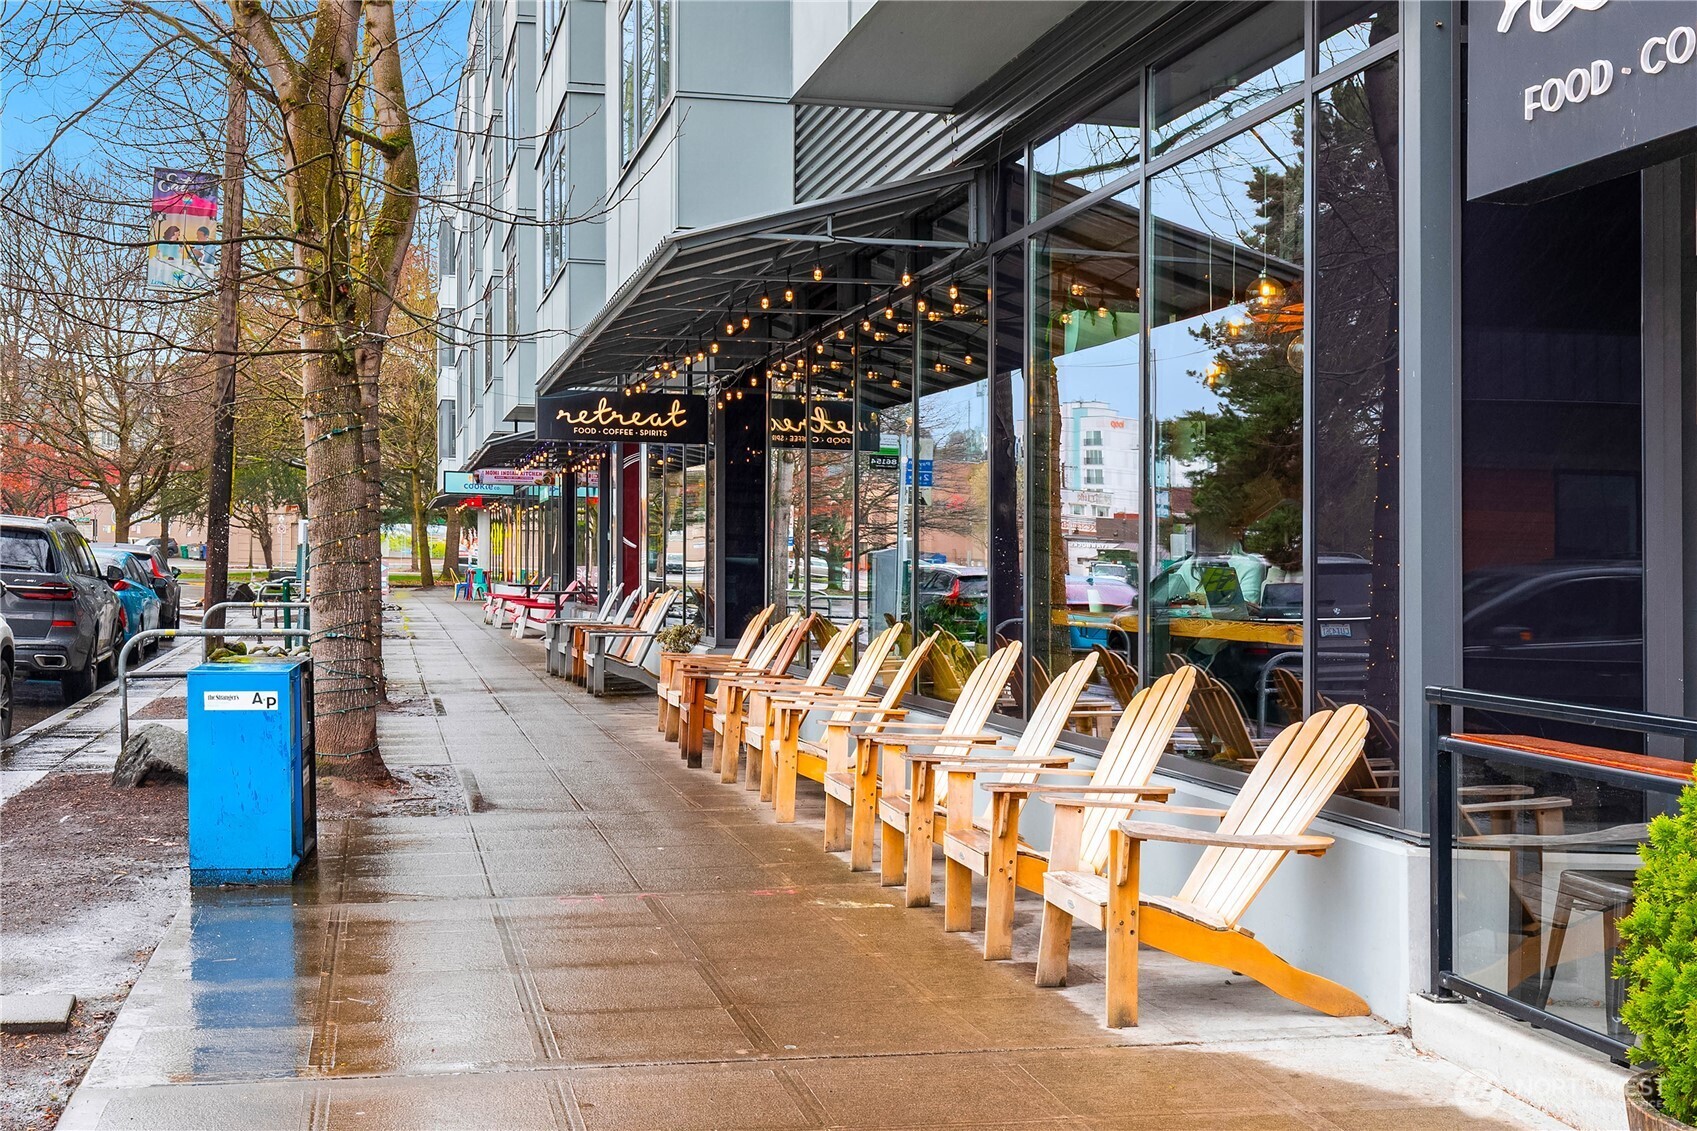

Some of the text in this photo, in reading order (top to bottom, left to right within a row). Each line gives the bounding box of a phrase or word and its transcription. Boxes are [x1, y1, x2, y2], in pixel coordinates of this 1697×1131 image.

[1524, 26, 1697, 121] FOOD CO
[556, 397, 687, 428] retreat
[573, 427, 668, 437] FOOD COFFEE SPIRITS
